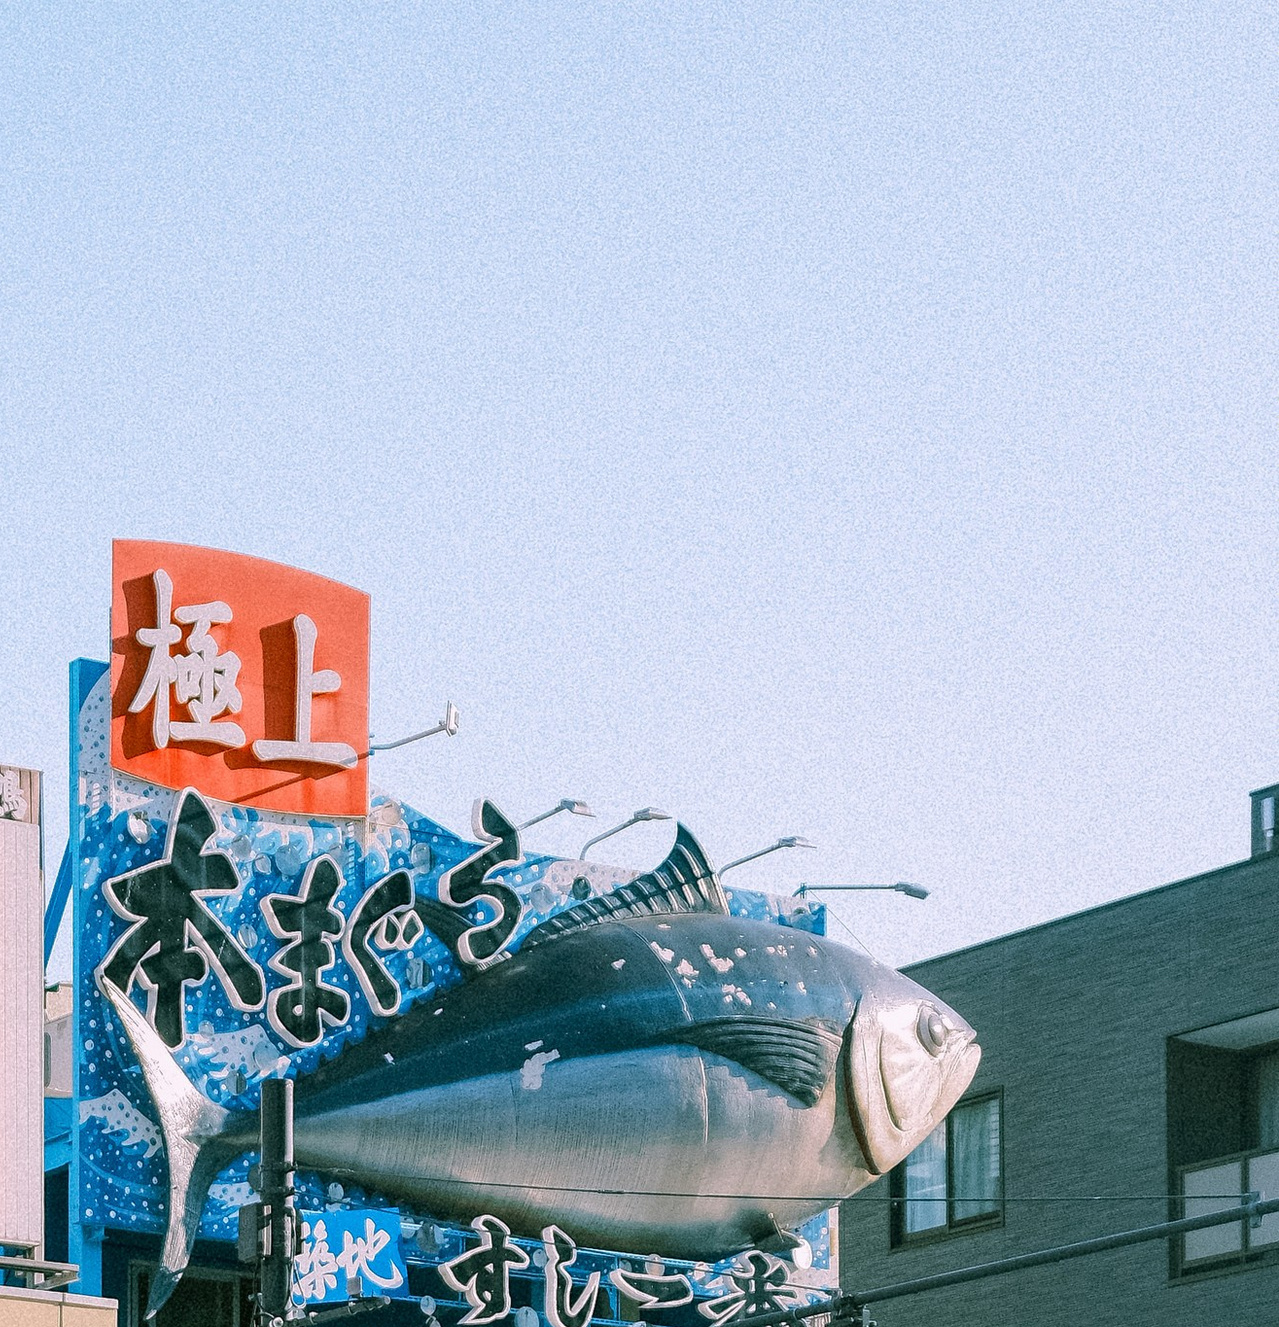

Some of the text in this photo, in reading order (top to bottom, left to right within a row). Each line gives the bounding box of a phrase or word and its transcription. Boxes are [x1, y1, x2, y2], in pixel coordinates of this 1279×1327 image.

[128, 568, 358, 769] 極上
[95, 787, 522, 1051] 本まぐろ
